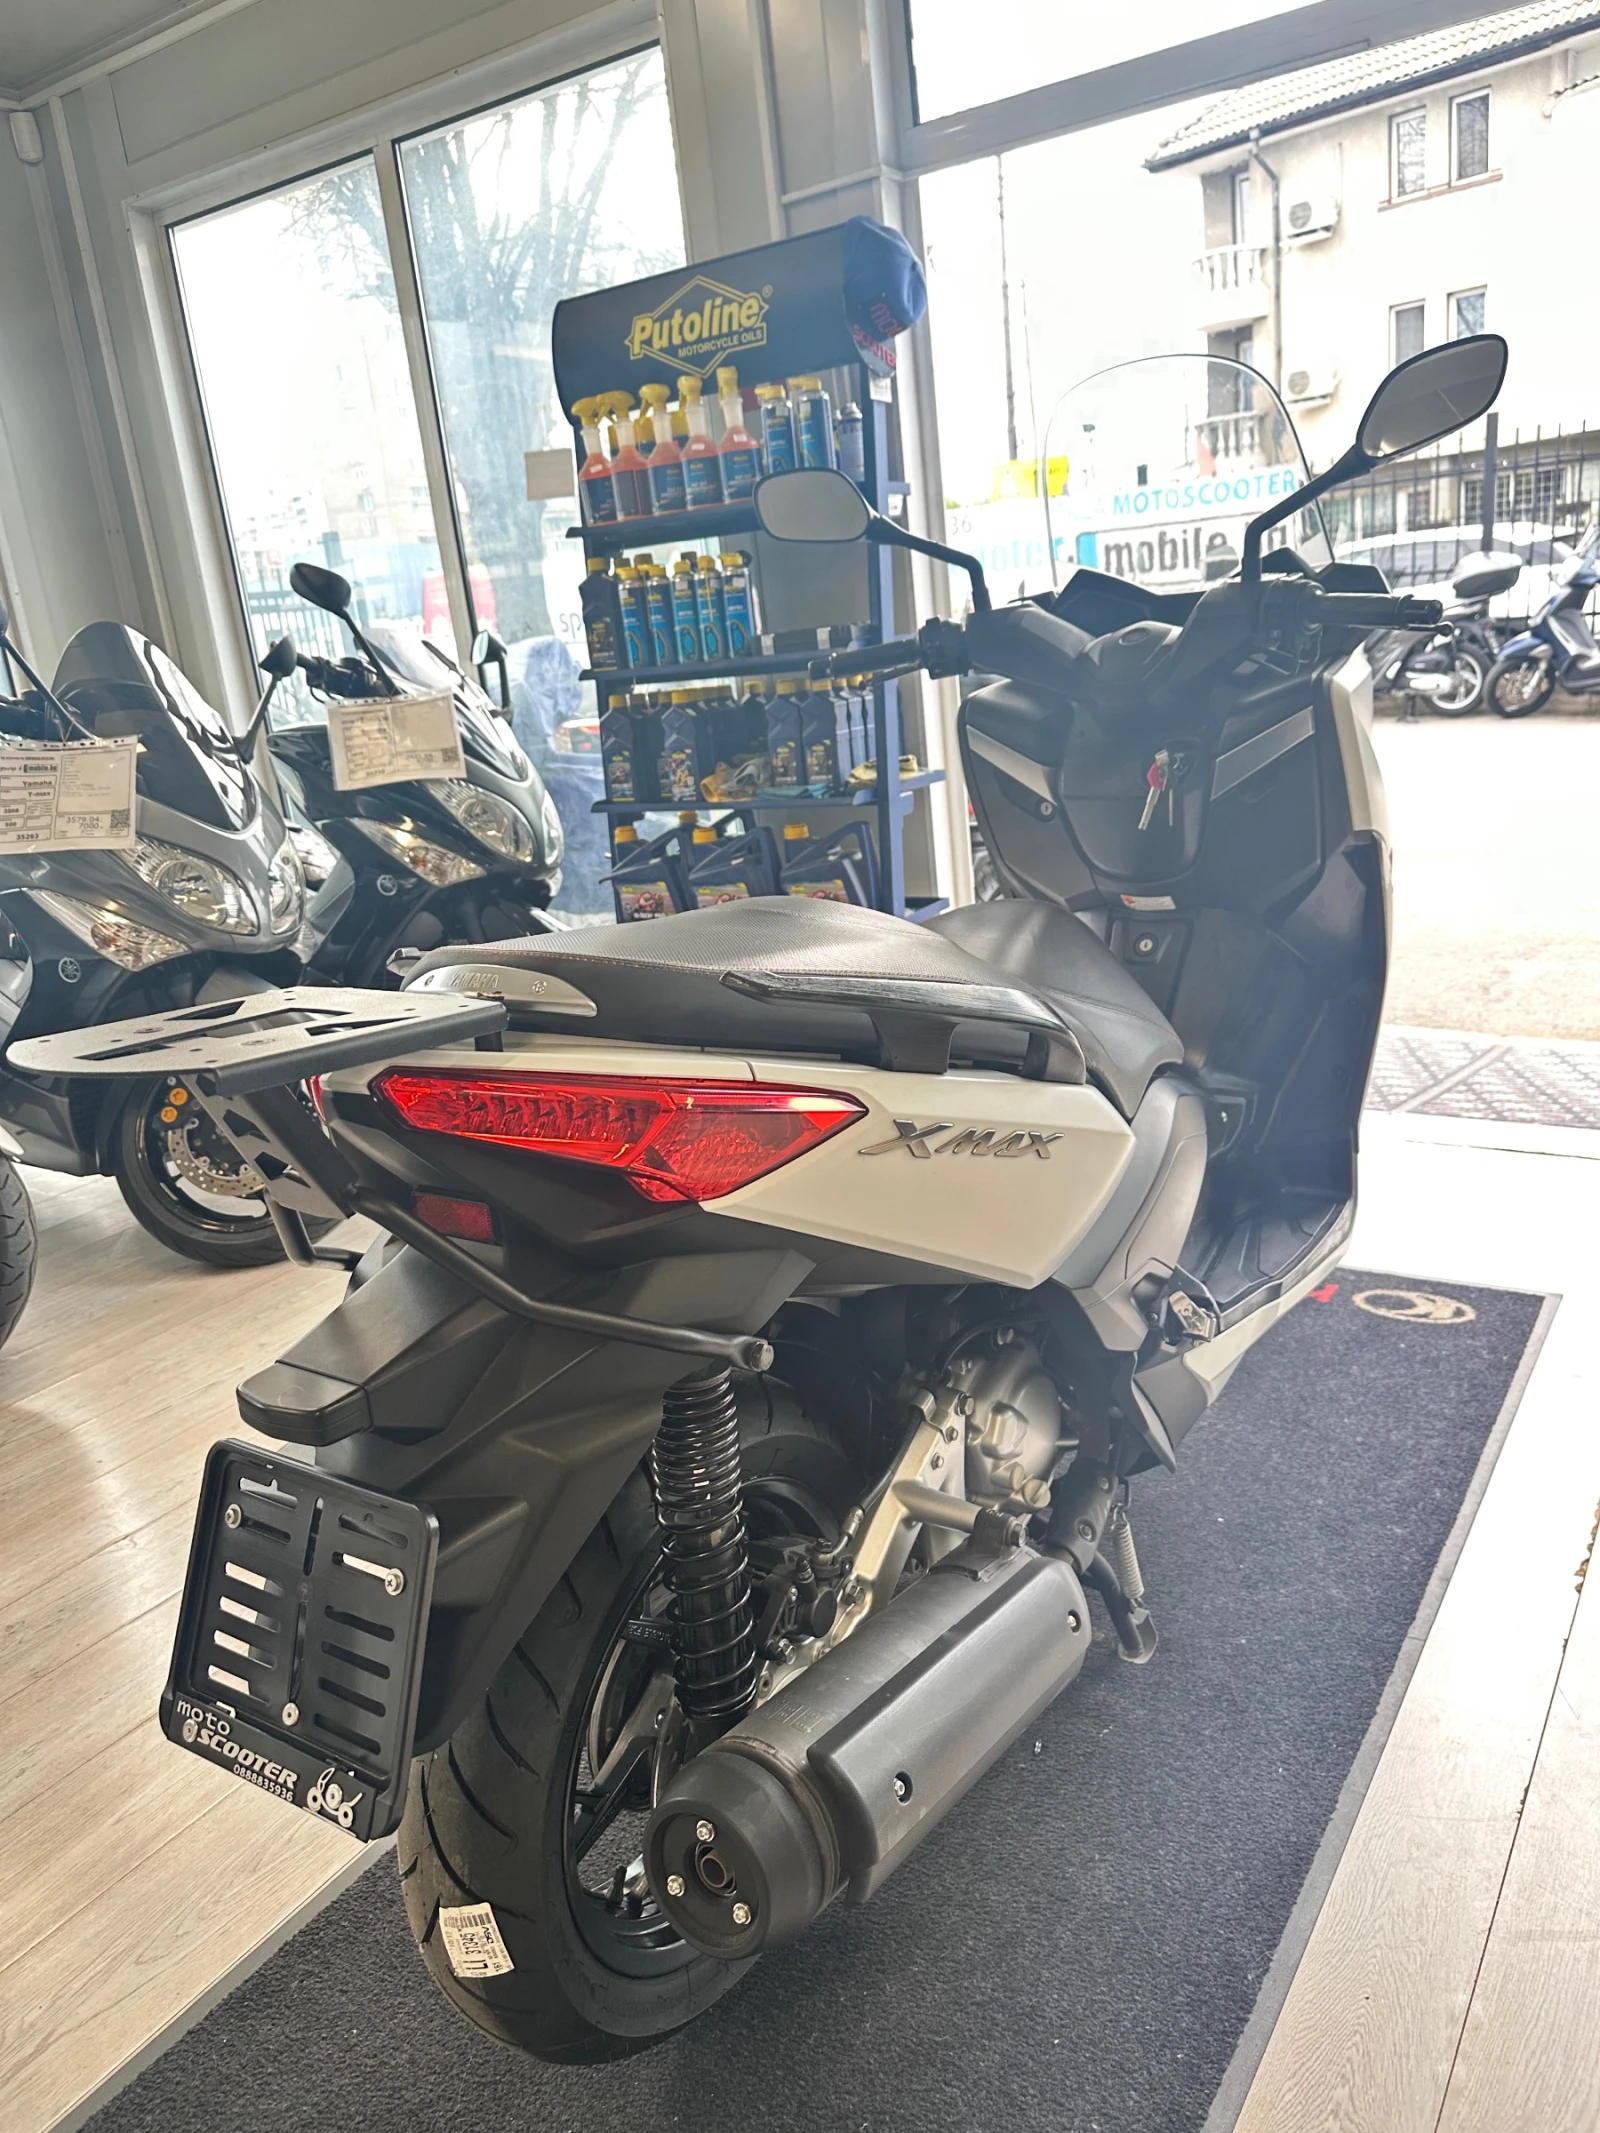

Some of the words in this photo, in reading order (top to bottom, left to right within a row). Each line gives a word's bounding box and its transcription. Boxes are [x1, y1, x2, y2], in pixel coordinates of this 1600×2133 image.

[632, 296, 760, 354] Putoline
[678, 338, 740, 358] MOTORCYCLE
[741, 330, 763, 344] OILS
[1113, 469, 1297, 515] MOTOSCOOTER
[22, 780, 52, 788] Yamaha
[449, 973, 499, 988] YAMAHA
[176, 1699, 231, 1736] moto
[196, 1727, 299, 1790] SCOOTER
[233, 1763, 295, 1802] 0888835936
